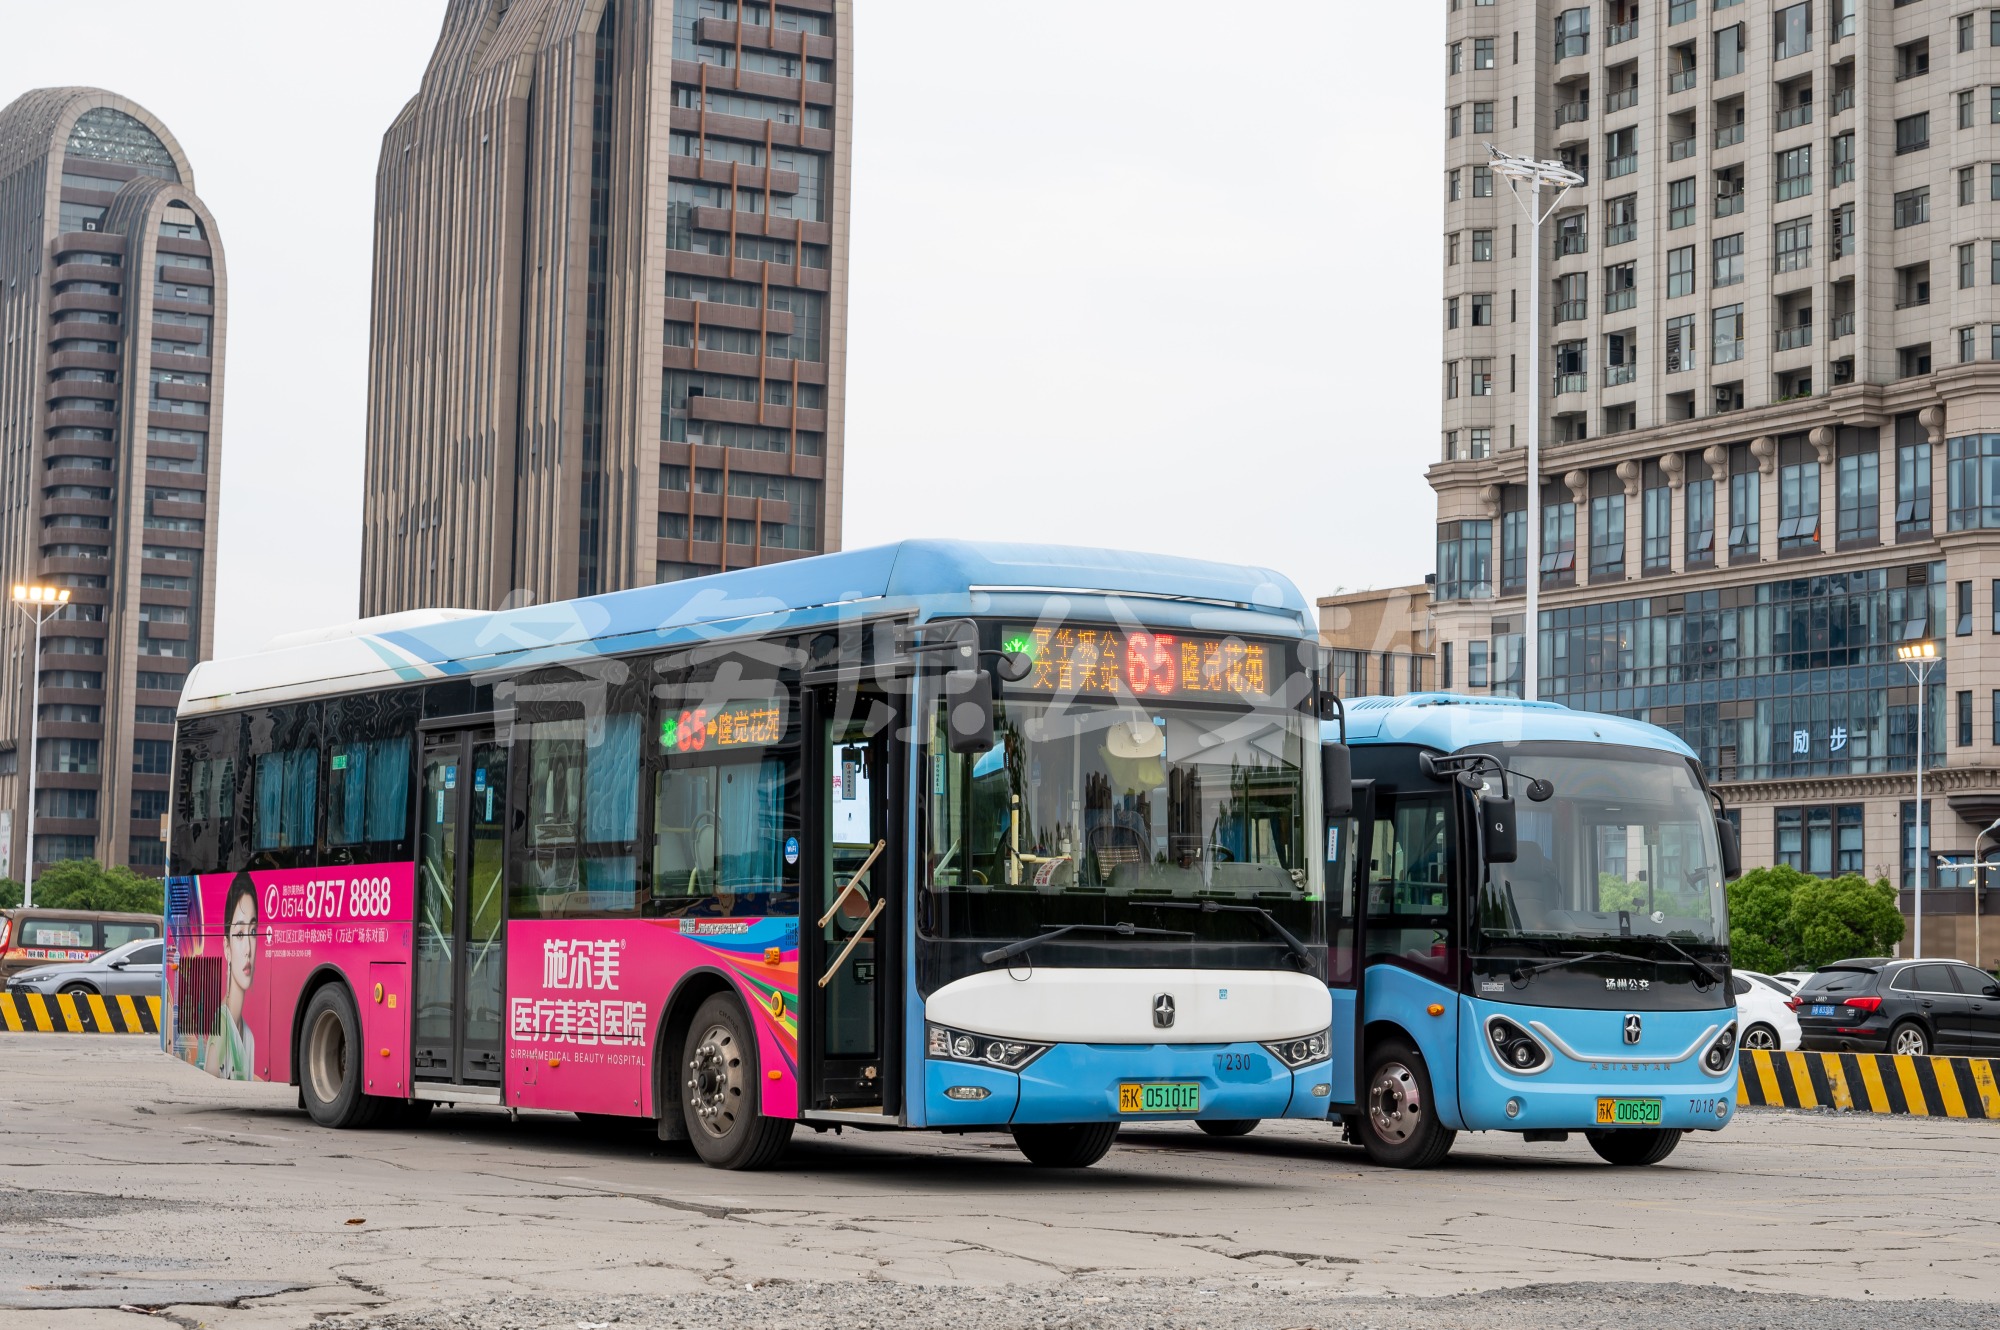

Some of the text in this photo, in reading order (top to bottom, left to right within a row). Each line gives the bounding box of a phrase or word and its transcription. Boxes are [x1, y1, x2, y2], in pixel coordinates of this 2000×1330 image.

[1032, 627, 1118, 659] 京华城公
[1033, 657, 1118, 693] 交首末站
[1127, 632, 1265, 694] 65 隆觉花苑
[677, 708, 779, 752] 65 隆觉花苑
[1792, 726, 1848, 753] 励步
[1495, 822, 1504, 833] Q
[281, 876, 391, 919] 0514 8757 8888
[542, 939, 620, 990] 施尔美
[1605, 978, 1650, 990] 扬州公交
[511, 997, 647, 1047] 医疗美容医院
[537, 1050, 571, 1062] MEDICAL
[574, 1052, 605, 1064] BEAUTY
[607, 1054, 646, 1067] HOSPITAL
[1216, 1053, 1251, 1070] 7230
[1589, 1062, 1671, 1071] ASIASTAR
[1689, 1099, 1714, 1113] 7018
